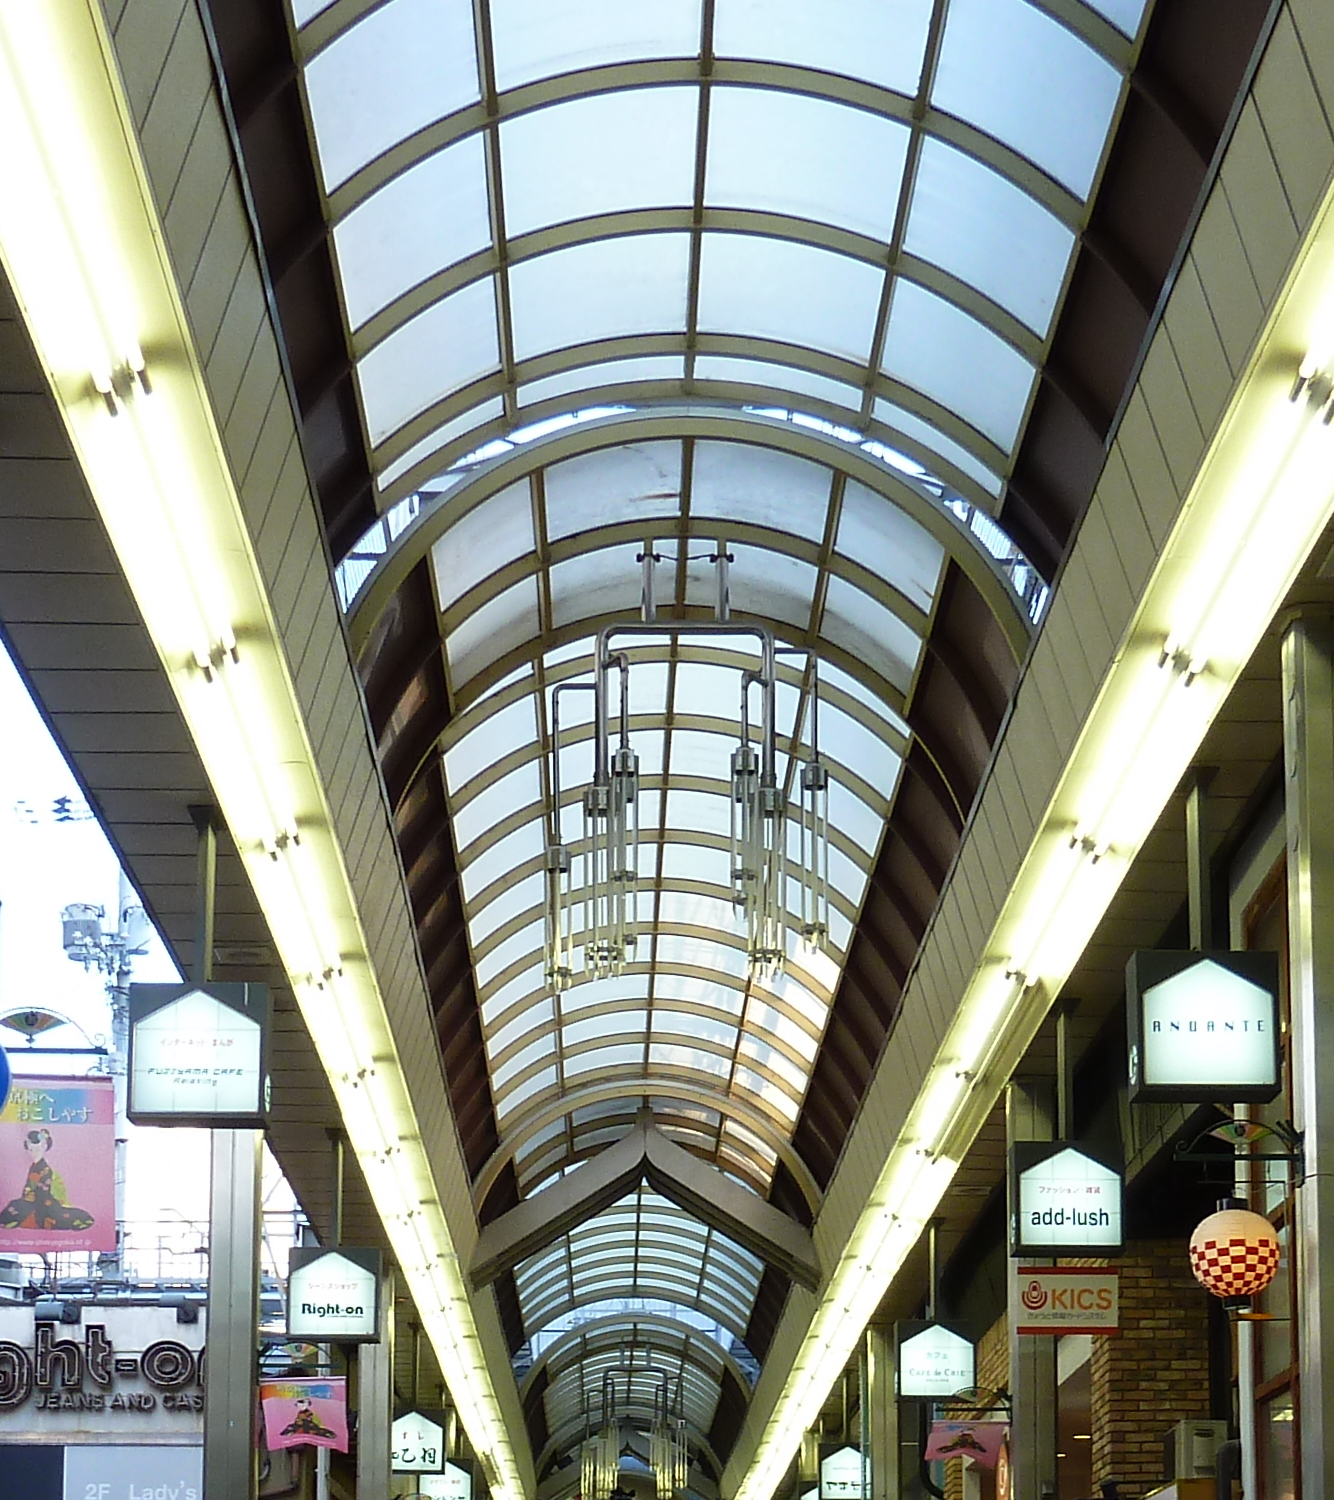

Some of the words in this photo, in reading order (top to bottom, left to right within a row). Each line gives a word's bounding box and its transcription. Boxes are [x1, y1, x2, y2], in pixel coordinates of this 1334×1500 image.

[147, 1067, 209, 1075] FUJIYAMA
[213, 1068, 244, 1076] CAFE
[17, 1105, 93, 1123] おこしやす
[1030, 1207, 1110, 1226] add-lush
[1050, 1287, 1113, 1311] KICS
[301, 1302, 364, 1318] Right-on
[35, 1393, 106, 1410] JEANS
[110, 1393, 157, 1411] AND
[162, 1393, 205, 1412] CAS
[84, 1483, 111, 1500] 2F
